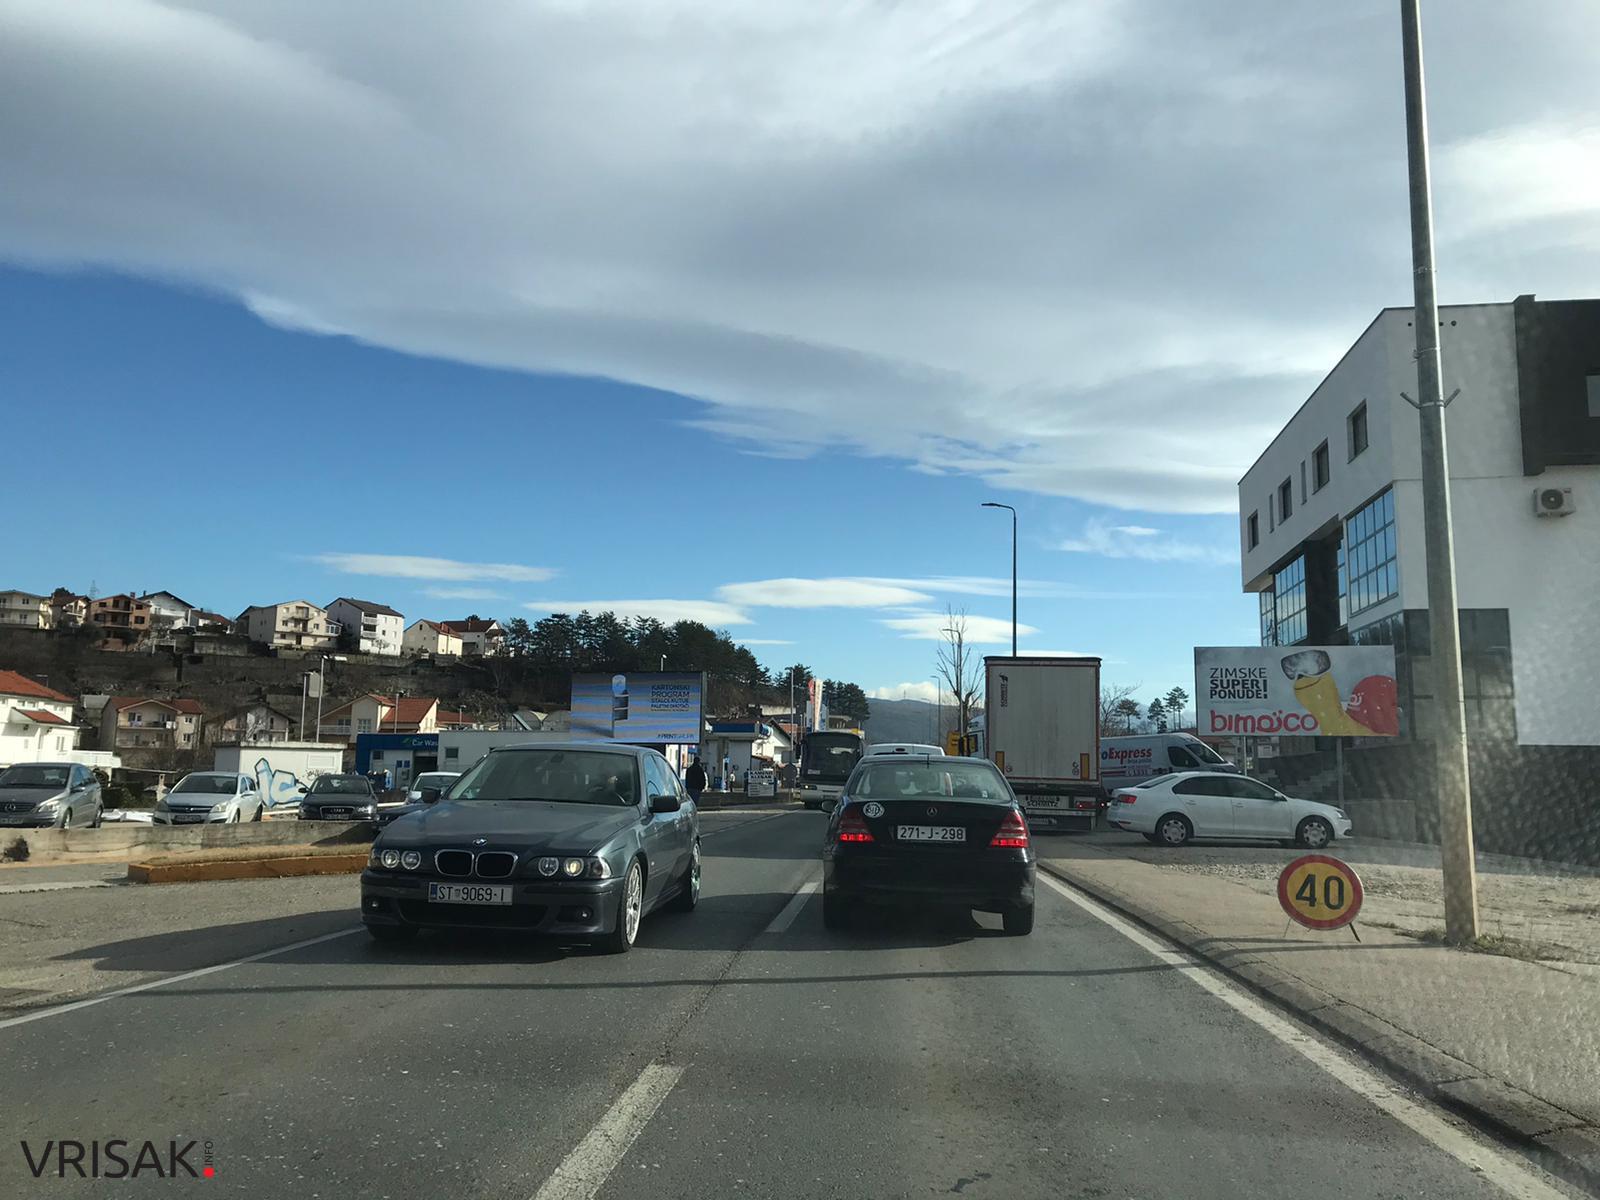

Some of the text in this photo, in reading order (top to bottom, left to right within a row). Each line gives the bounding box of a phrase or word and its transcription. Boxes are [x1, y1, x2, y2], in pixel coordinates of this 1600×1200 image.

[1210, 667, 1267, 678] ZIMSKE
[1210, 679, 1260, 689] SUPER
[900, 826, 964, 841] 271-J-298
[438, 886, 453, 900] ST
[1296, 873, 1344, 910] 40
